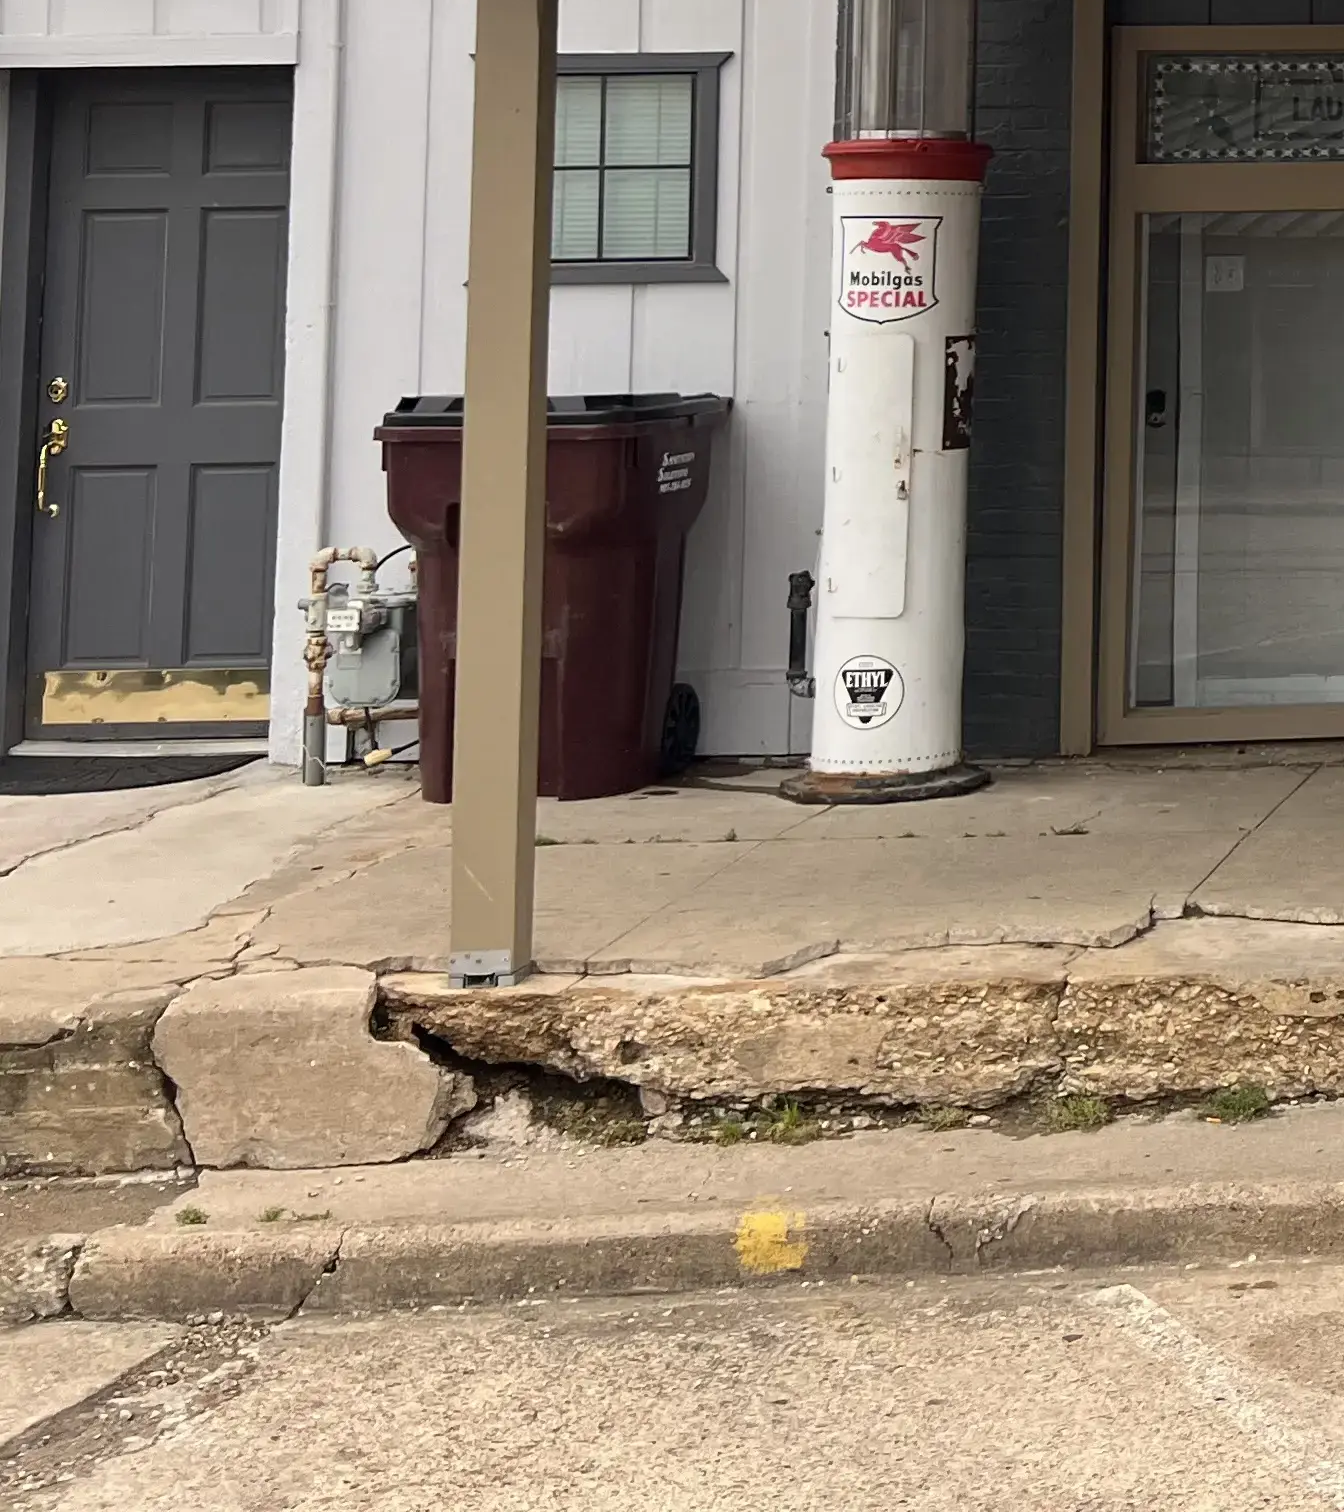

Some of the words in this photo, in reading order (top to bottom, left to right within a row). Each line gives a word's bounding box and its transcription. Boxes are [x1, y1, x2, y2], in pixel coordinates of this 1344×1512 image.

[849, 271, 923, 290] Mobilgas
[847, 290, 928, 308] SPECIAL
[845, 670, 889, 688] ETHYL
